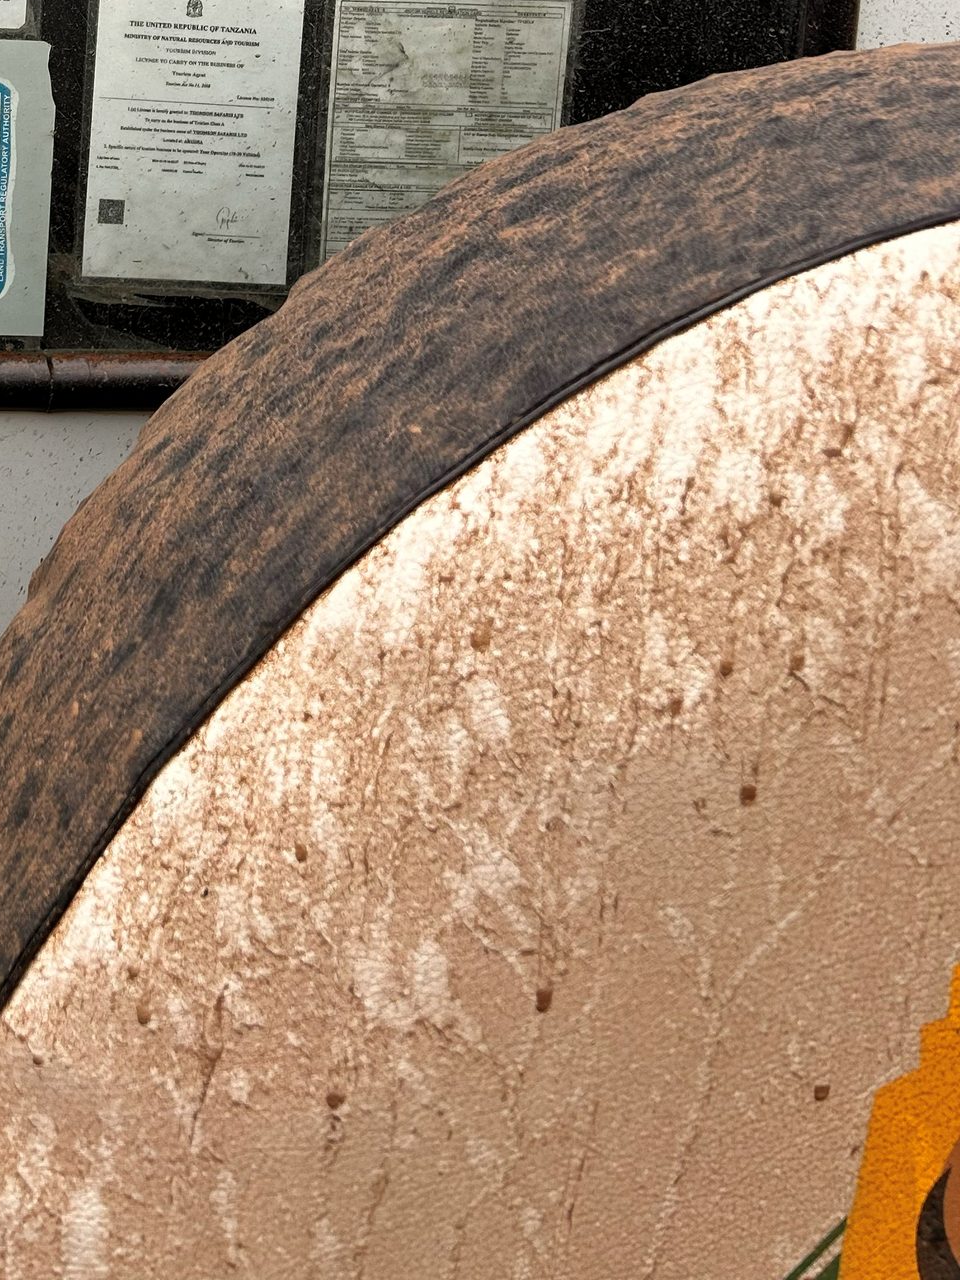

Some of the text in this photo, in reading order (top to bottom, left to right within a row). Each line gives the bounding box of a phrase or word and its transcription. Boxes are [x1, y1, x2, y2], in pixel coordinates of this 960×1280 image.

[146, 21, 172, 29] UNITED
[174, 23, 208, 31] REPUBLIC
[221, 26, 256, 34] TANZANIA
